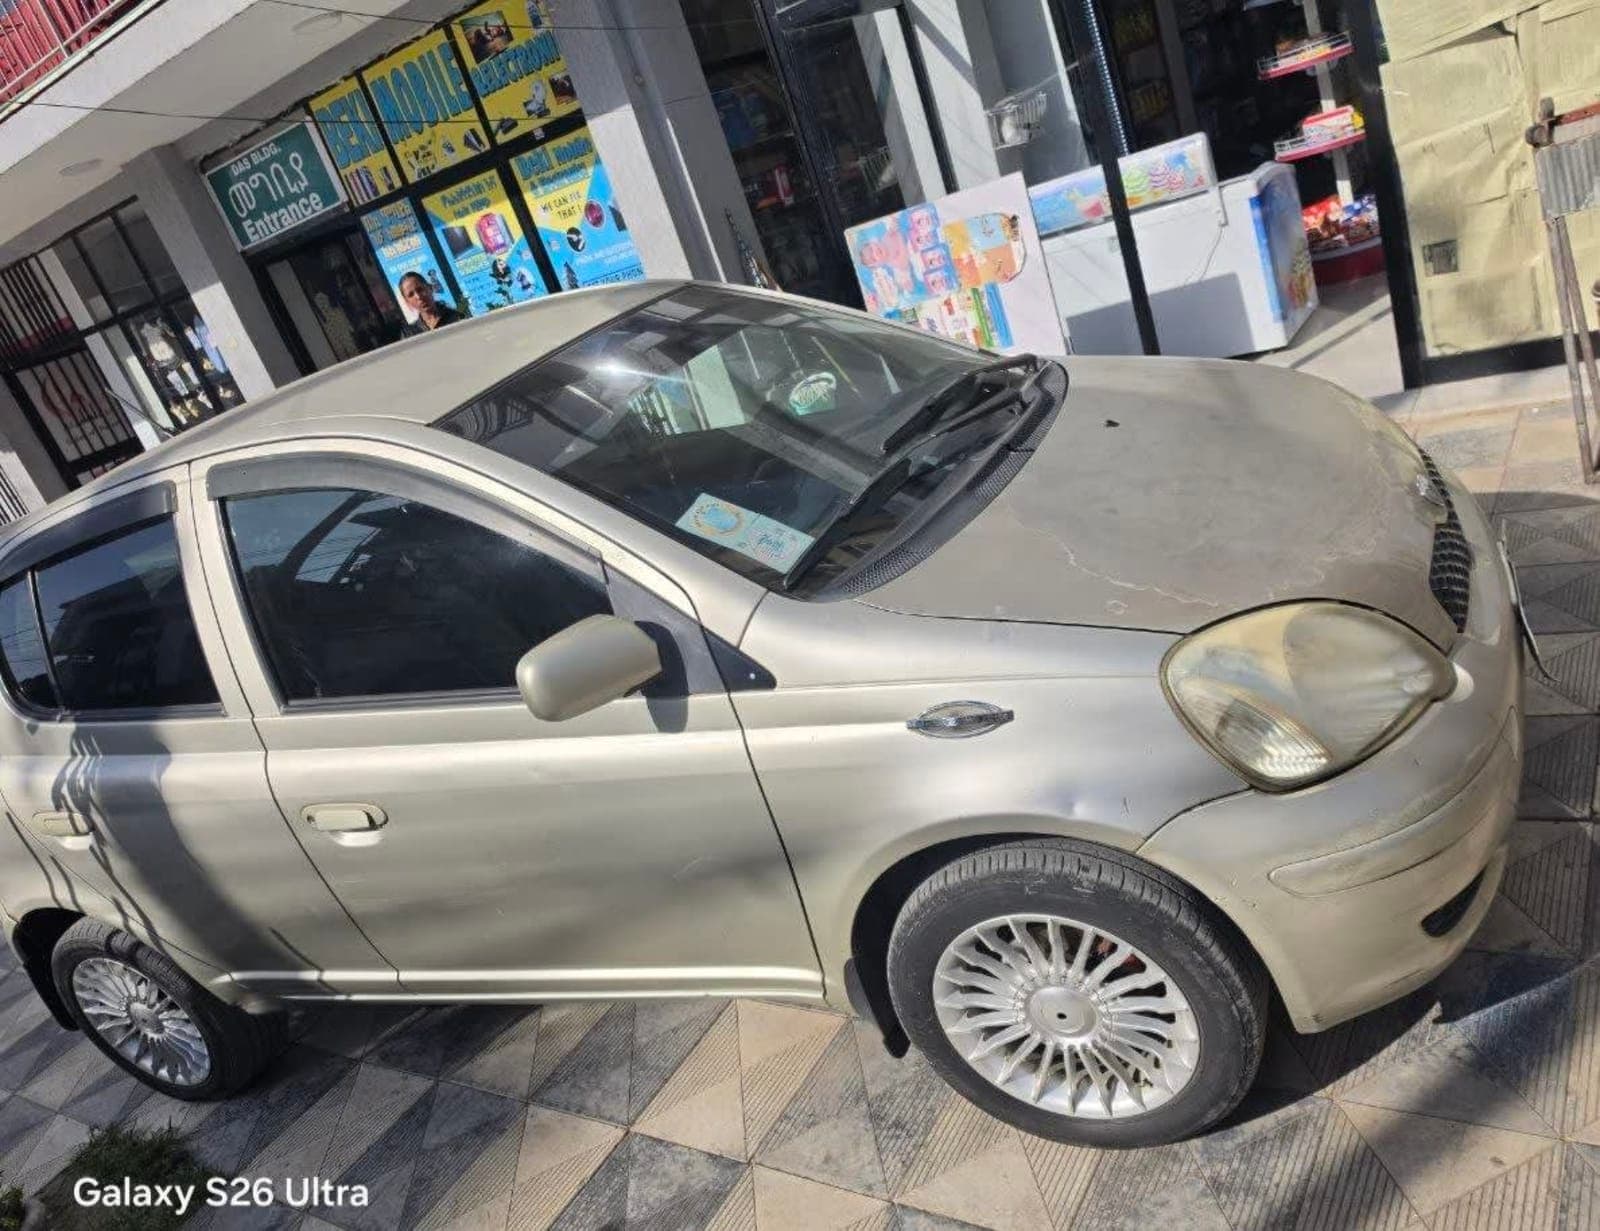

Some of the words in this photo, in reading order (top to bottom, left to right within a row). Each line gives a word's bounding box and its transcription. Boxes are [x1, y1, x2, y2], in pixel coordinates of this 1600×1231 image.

[315, 89, 385, 170] BEKI
[369, 40, 475, 145] MOBILE
[228, 152, 309, 218] መግቢያ
[231, 158, 252, 176] DAS
[251, 143, 282, 165] BLDG.
[242, 192, 324, 242] Entrance
